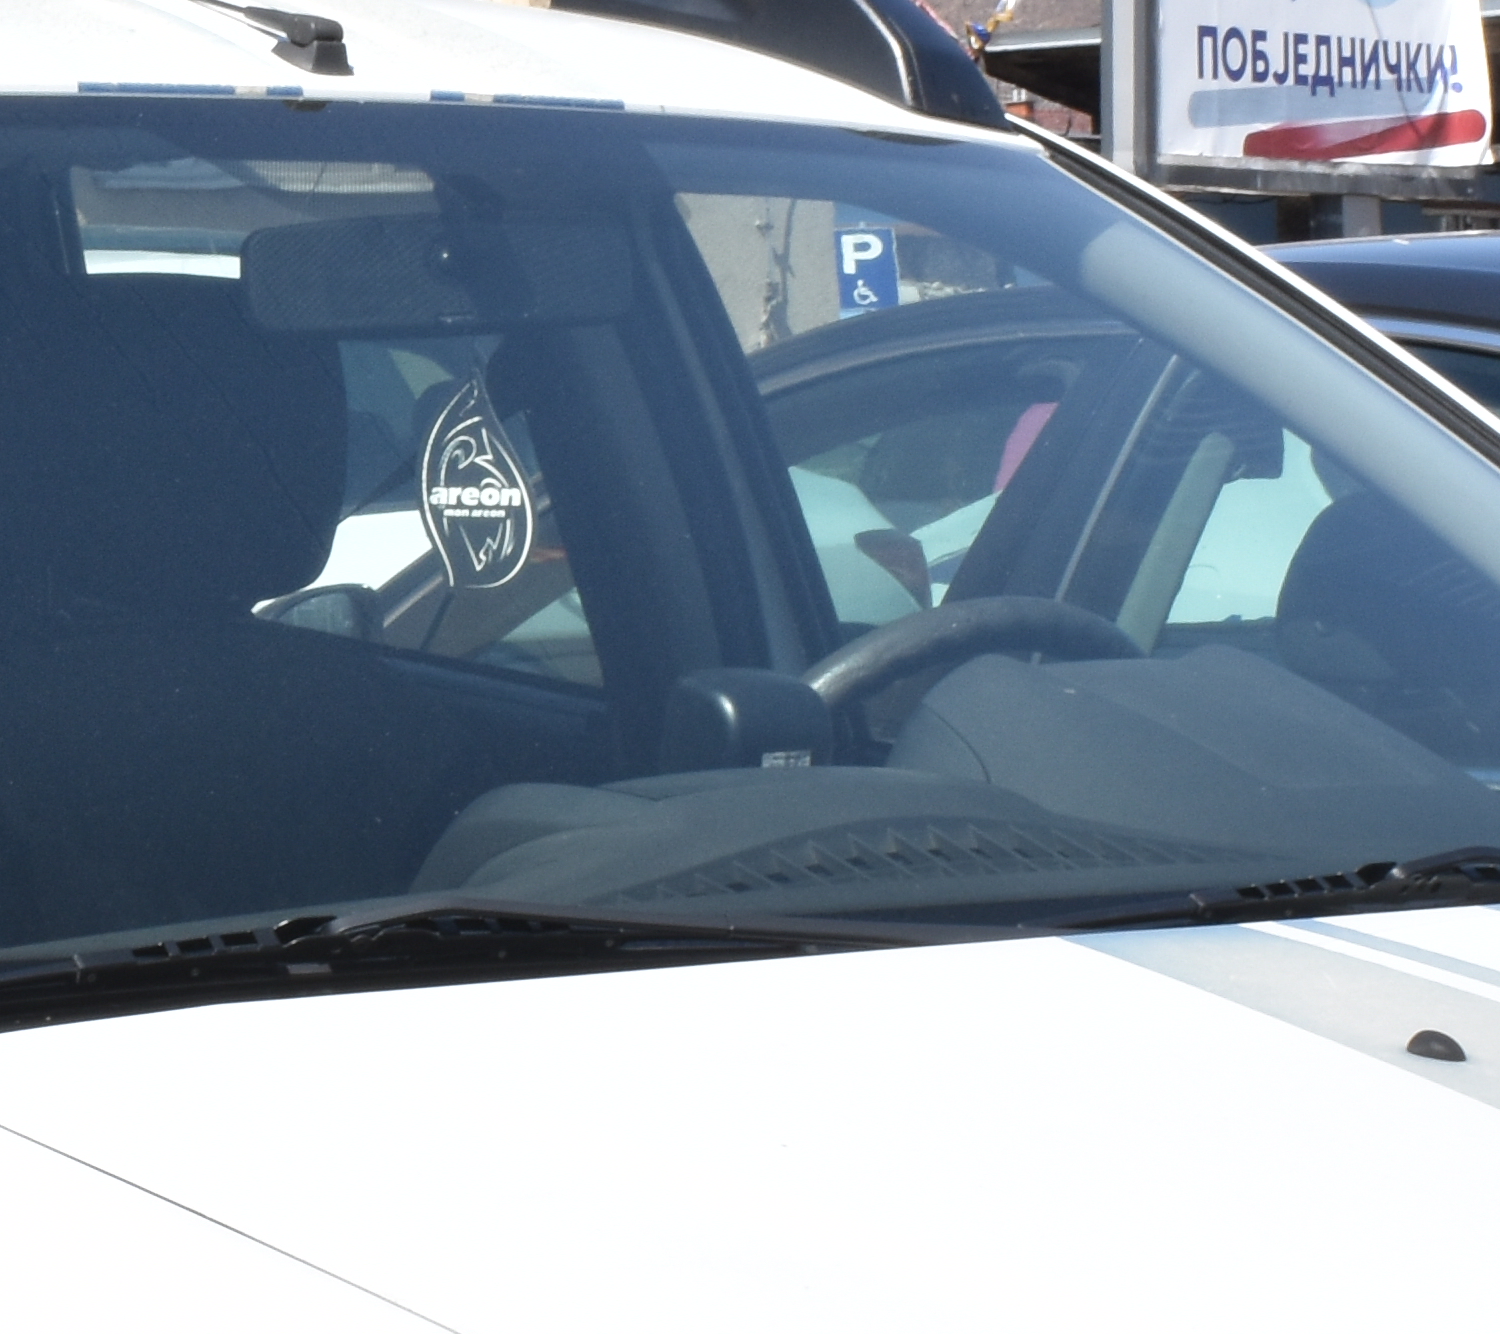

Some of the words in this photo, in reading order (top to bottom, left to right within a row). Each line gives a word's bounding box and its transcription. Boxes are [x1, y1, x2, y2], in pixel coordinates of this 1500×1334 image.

[1196, 24, 1463, 97] ПОБЈЕДНИЧКИ!
[840, 233, 883, 274] P
[429, 485, 522, 507] areon
